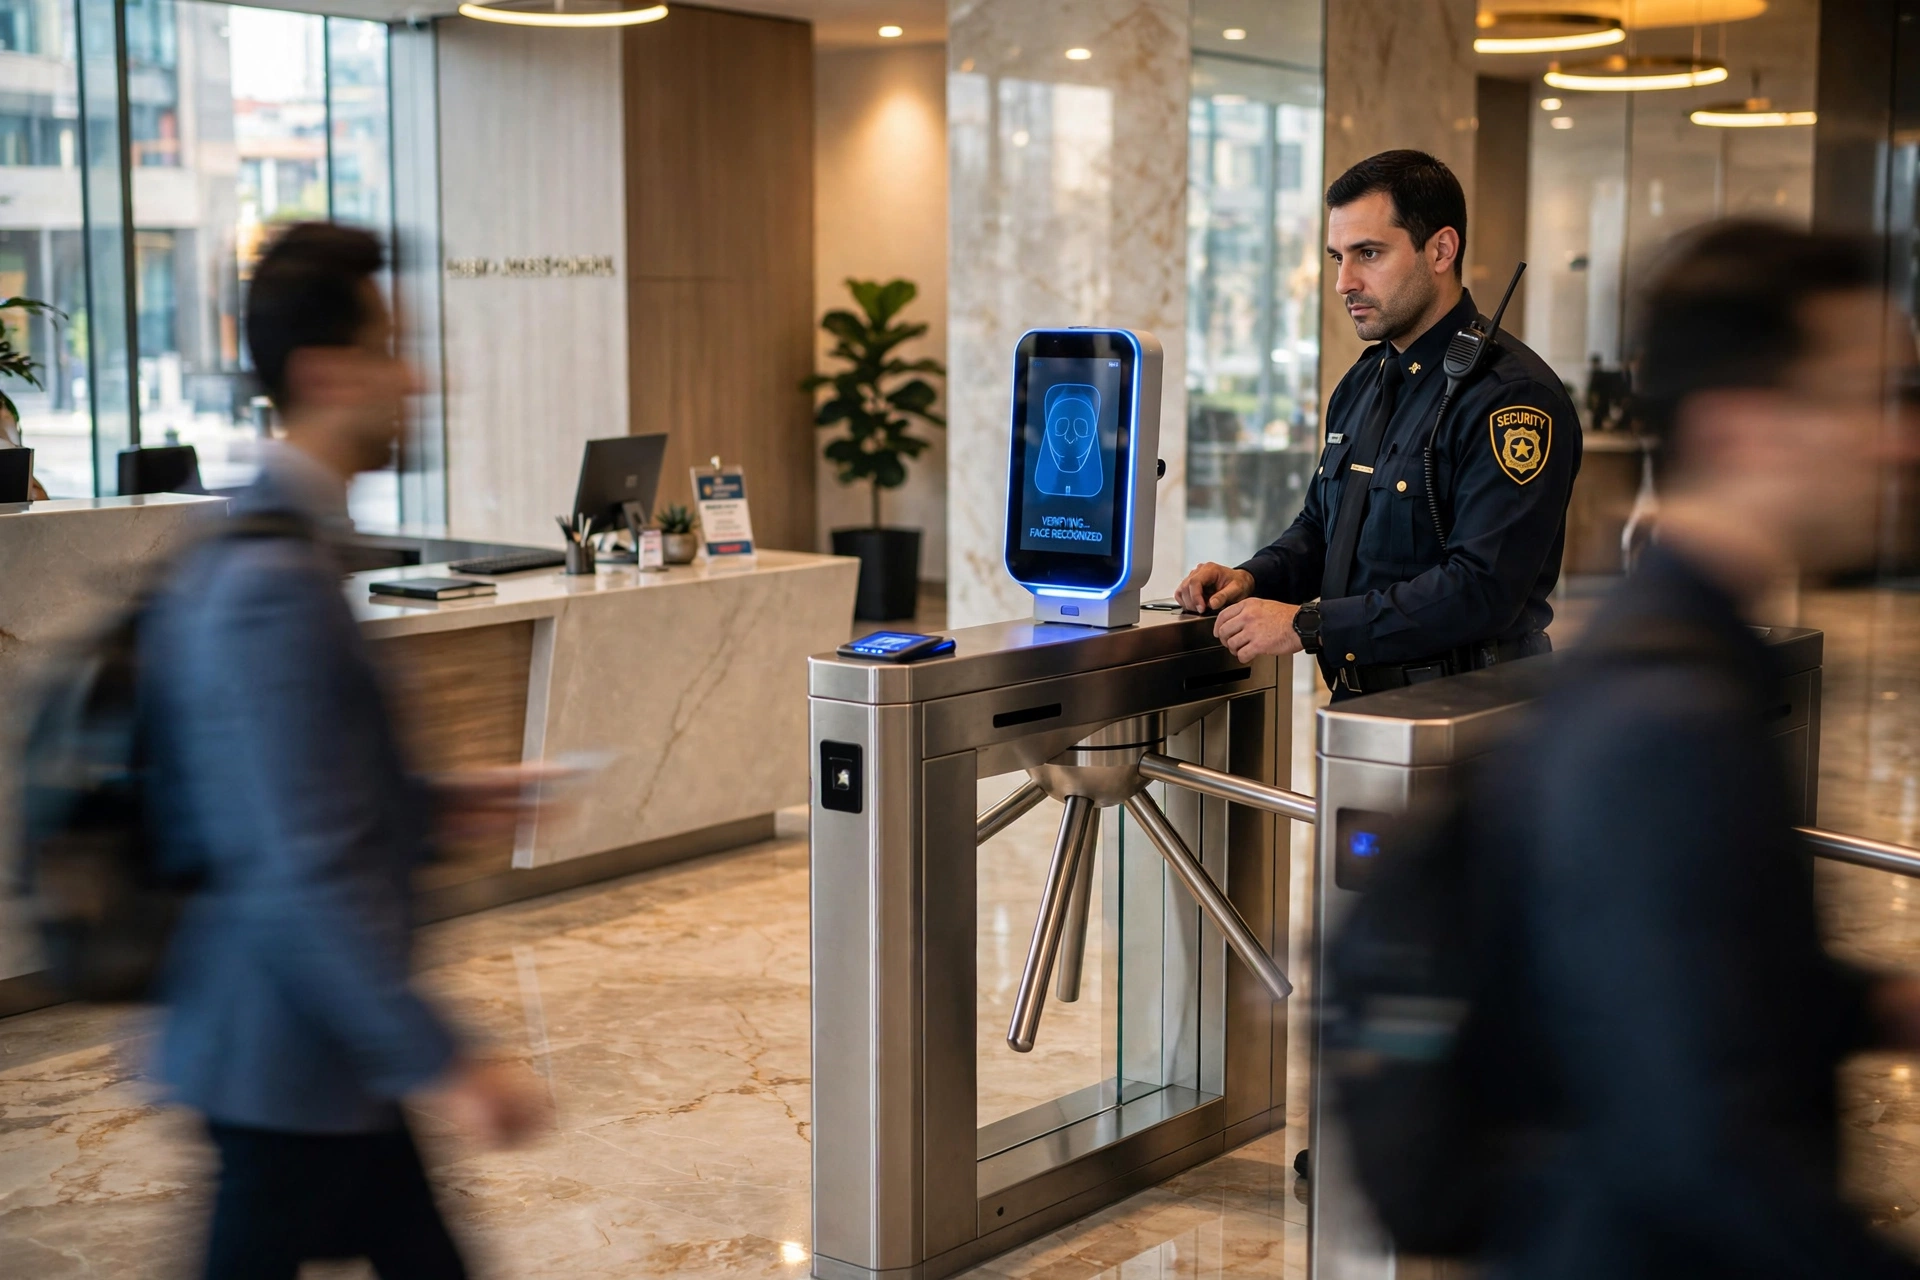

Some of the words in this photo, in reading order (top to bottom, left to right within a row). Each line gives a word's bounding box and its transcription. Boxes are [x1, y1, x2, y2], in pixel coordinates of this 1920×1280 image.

[1497, 411, 1546, 429] SECURITY
[1029, 527, 1050, 538] FACE
[1051, 528, 1103, 542] RECOGNIZED
